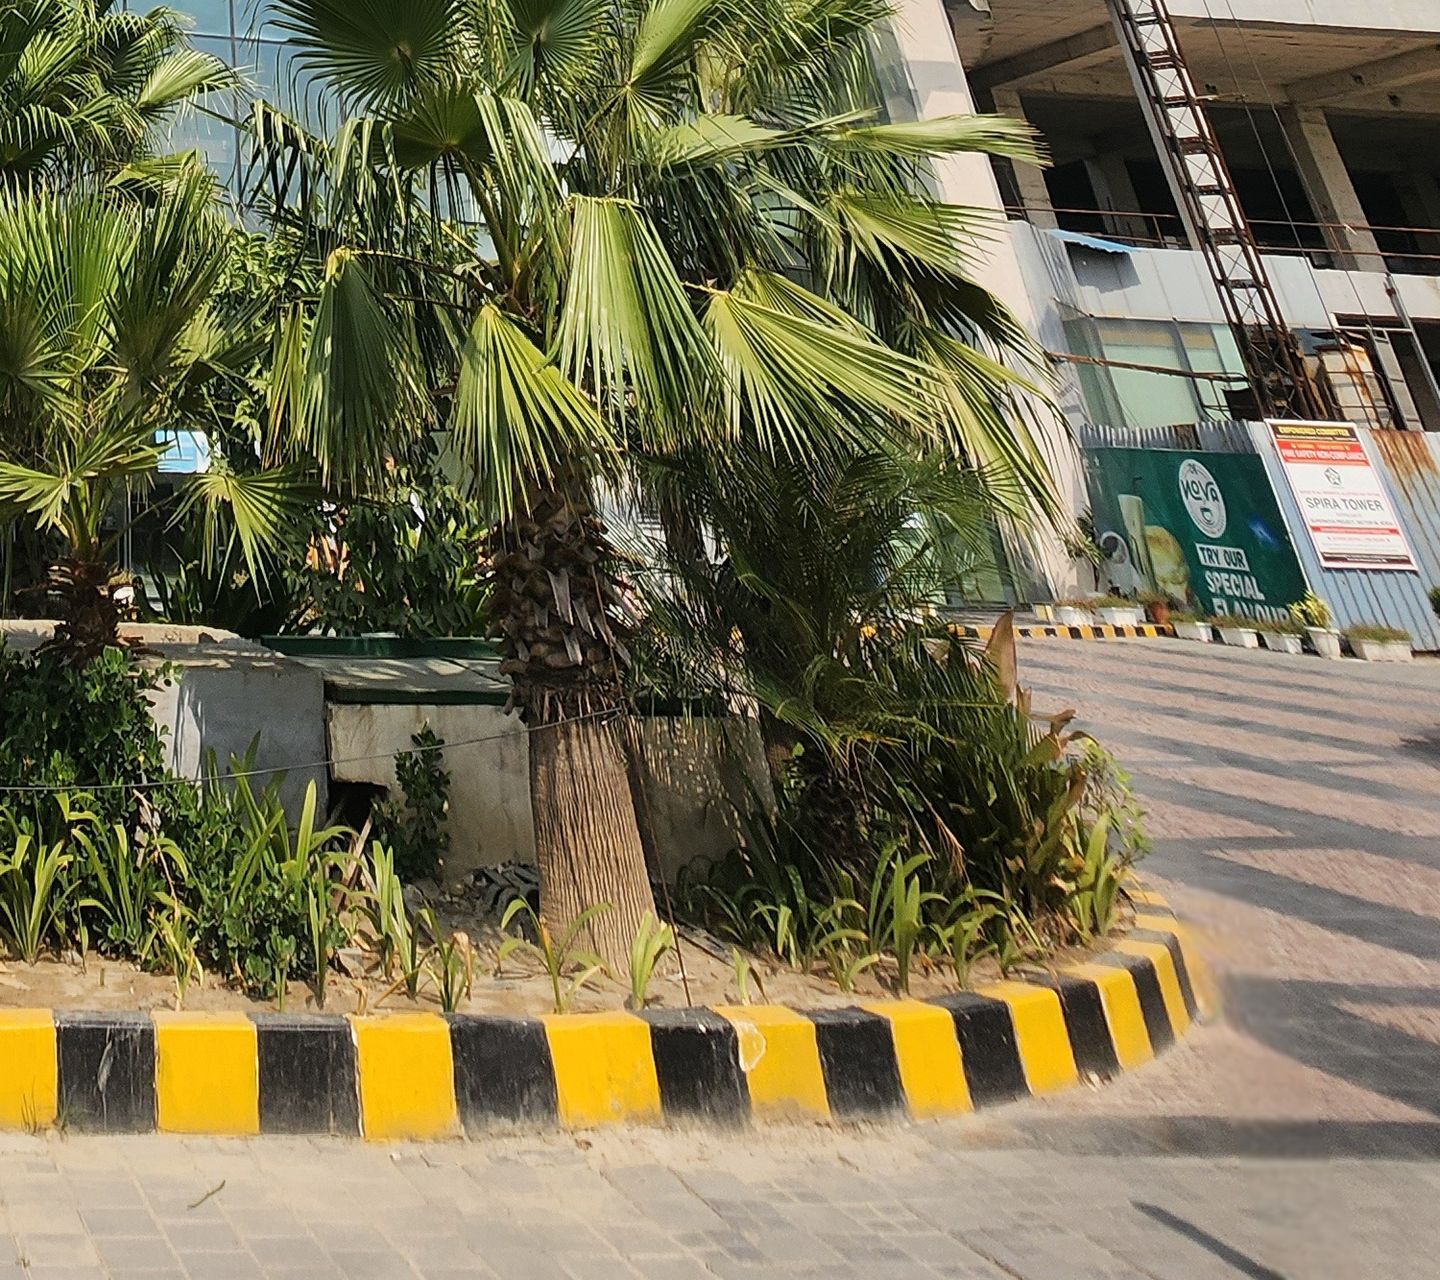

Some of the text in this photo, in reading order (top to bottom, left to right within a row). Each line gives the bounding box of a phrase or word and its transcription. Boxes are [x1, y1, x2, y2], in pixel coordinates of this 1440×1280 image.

[1305, 496, 1385, 512] SPIRA TOWER
[1199, 546, 1246, 569] TRY OUR
[1204, 570, 1266, 601] SPECIAL
